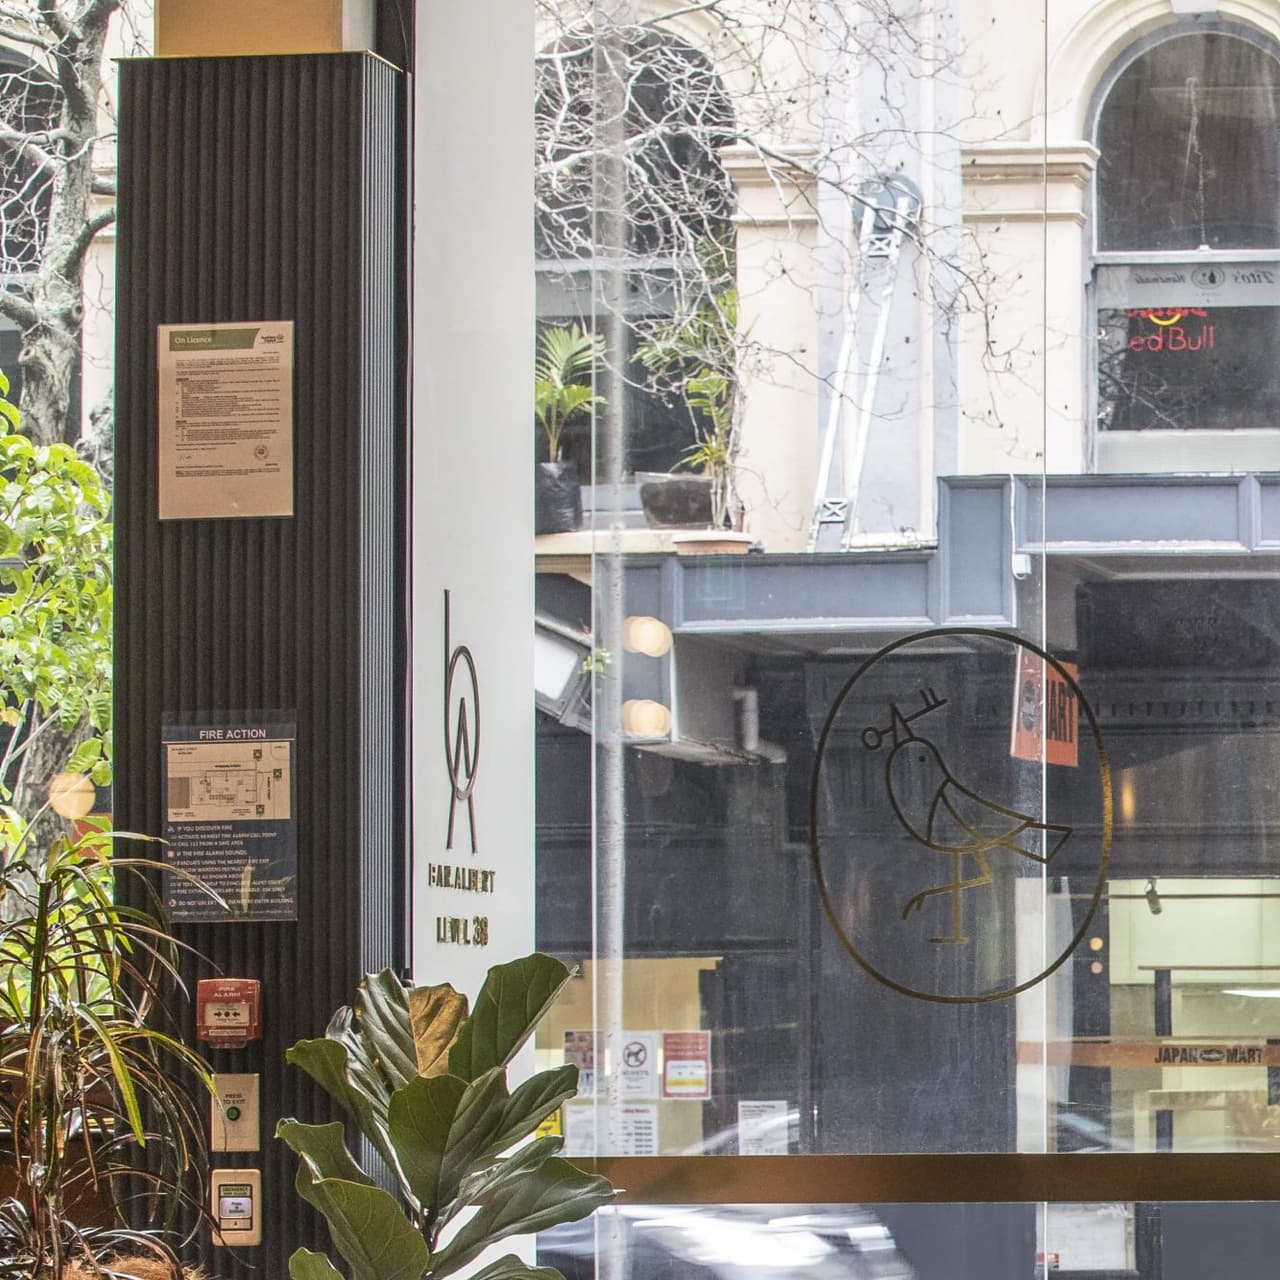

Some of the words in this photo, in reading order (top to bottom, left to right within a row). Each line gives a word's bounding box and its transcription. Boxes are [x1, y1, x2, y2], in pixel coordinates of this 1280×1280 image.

[1128, 326, 1164, 351] ed
[1168, 325, 1216, 351] Bull
[199, 730, 224, 739] FIRE
[226, 729, 266, 739] ACTION
[1154, 1047, 1199, 1064] JAPAN
[1226, 1047, 1263, 1064] MART
